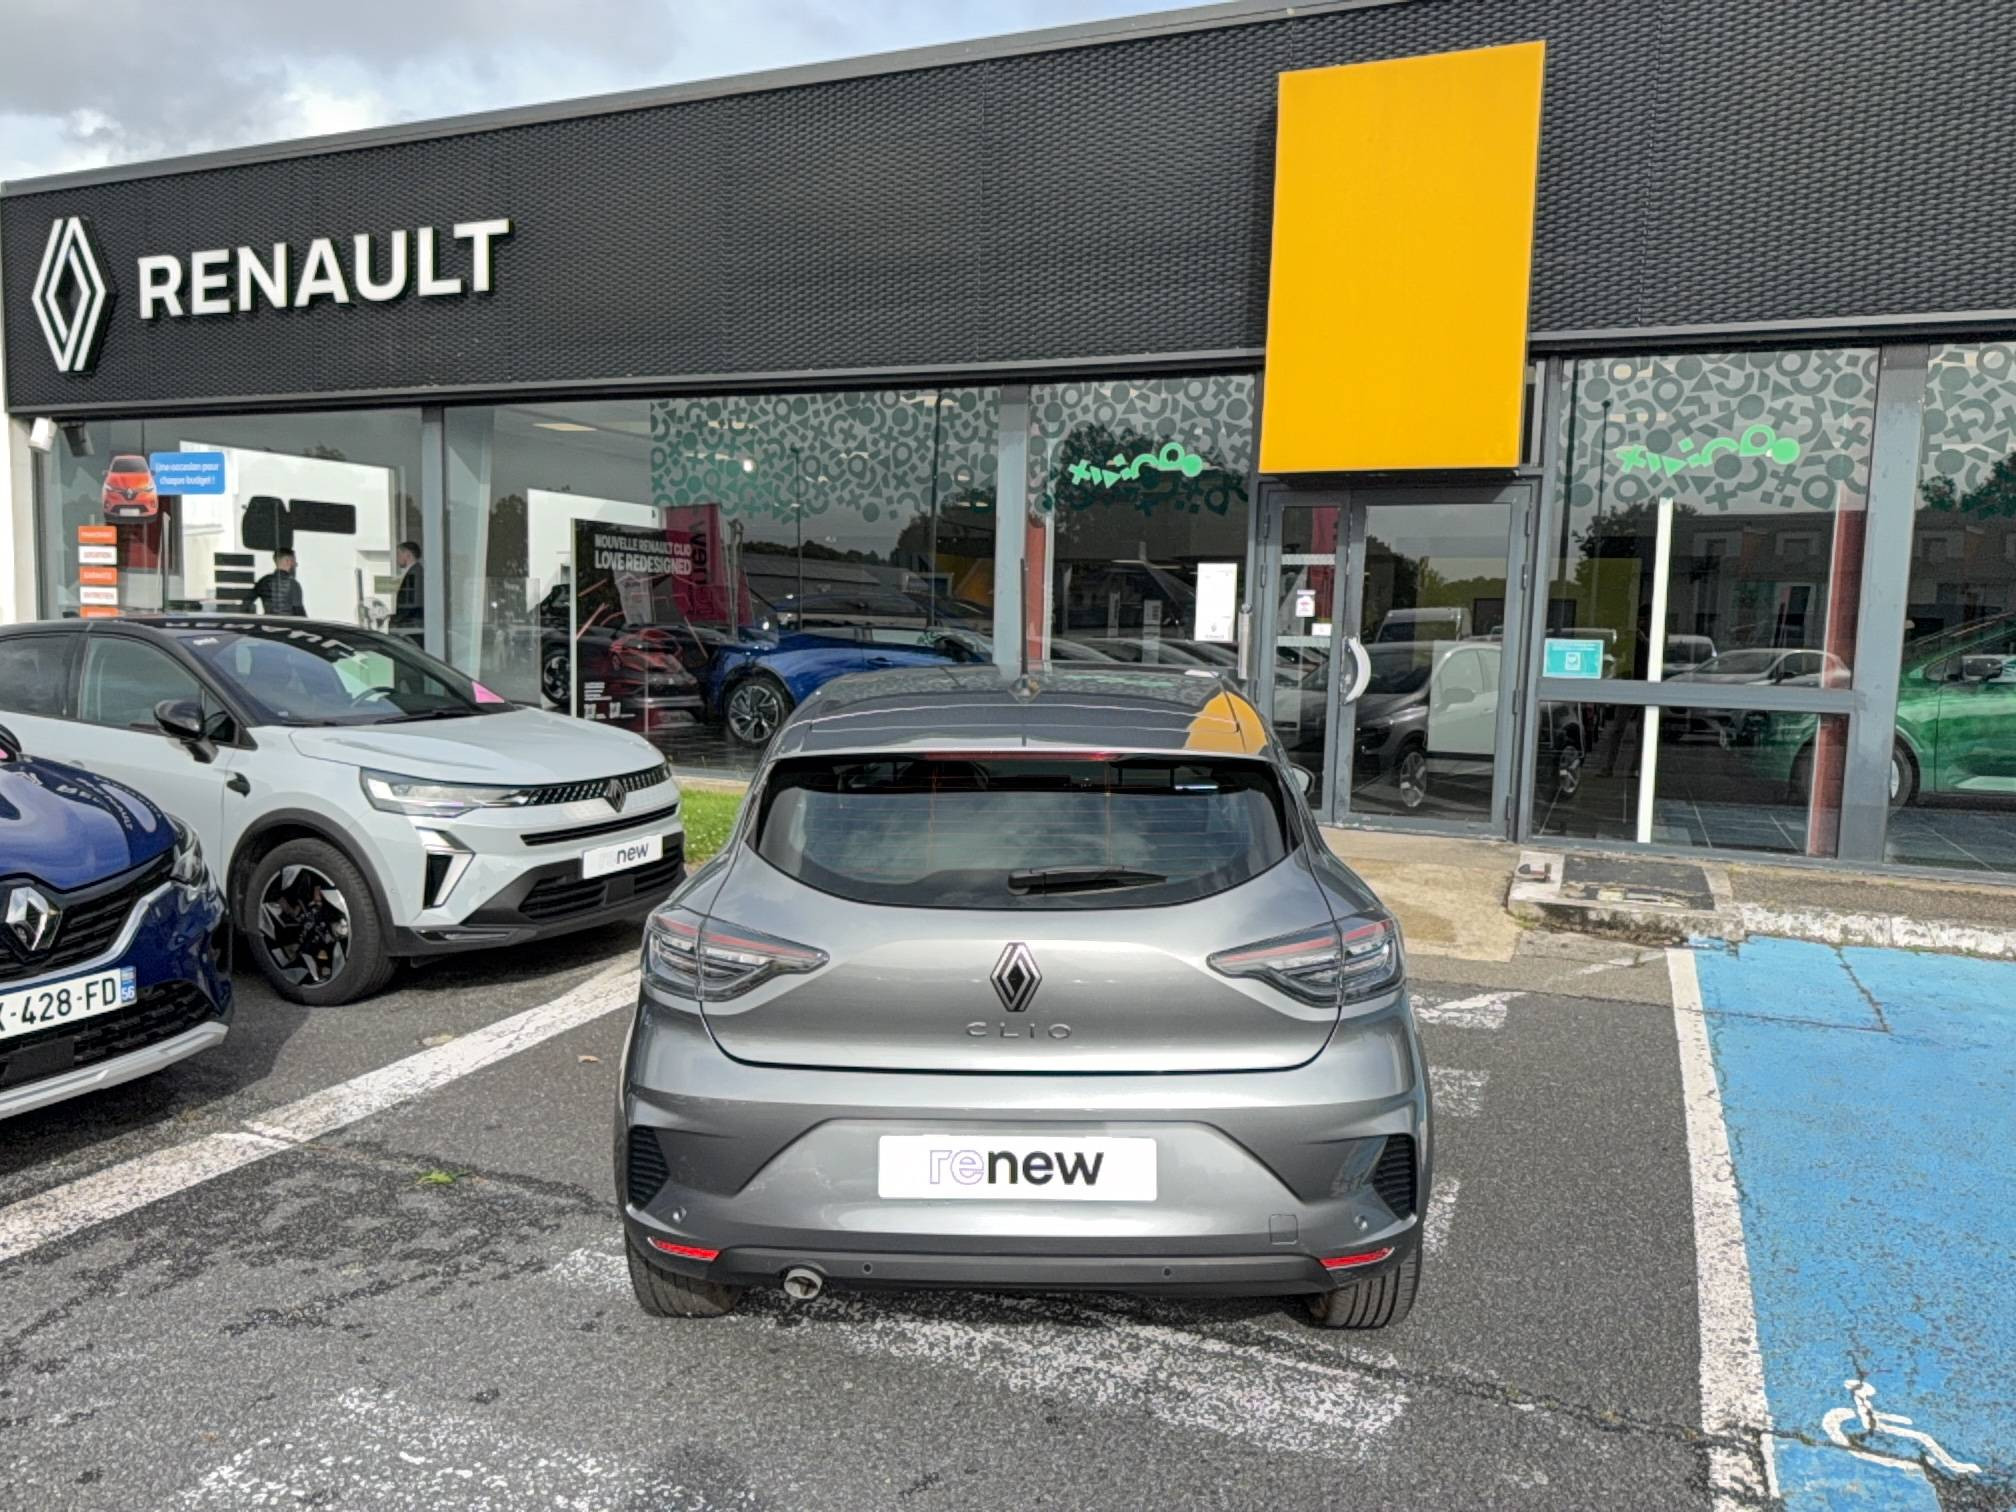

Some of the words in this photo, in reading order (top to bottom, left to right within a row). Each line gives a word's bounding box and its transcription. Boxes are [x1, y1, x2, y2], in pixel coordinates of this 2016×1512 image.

[138, 218, 510, 320] RENAULT
[594, 534, 638, 550] NOUVELLE
[639, 540, 673, 556] RENAULT
[673, 543, 692, 557] CLIO
[594, 550, 625, 571] LOVE
[626, 553, 692, 575] REDESIGNED
[121, 985, 135, 1000] 56
[965, 1021, 1072, 1039] CLIO
[929, 1149, 1105, 1186] renew
